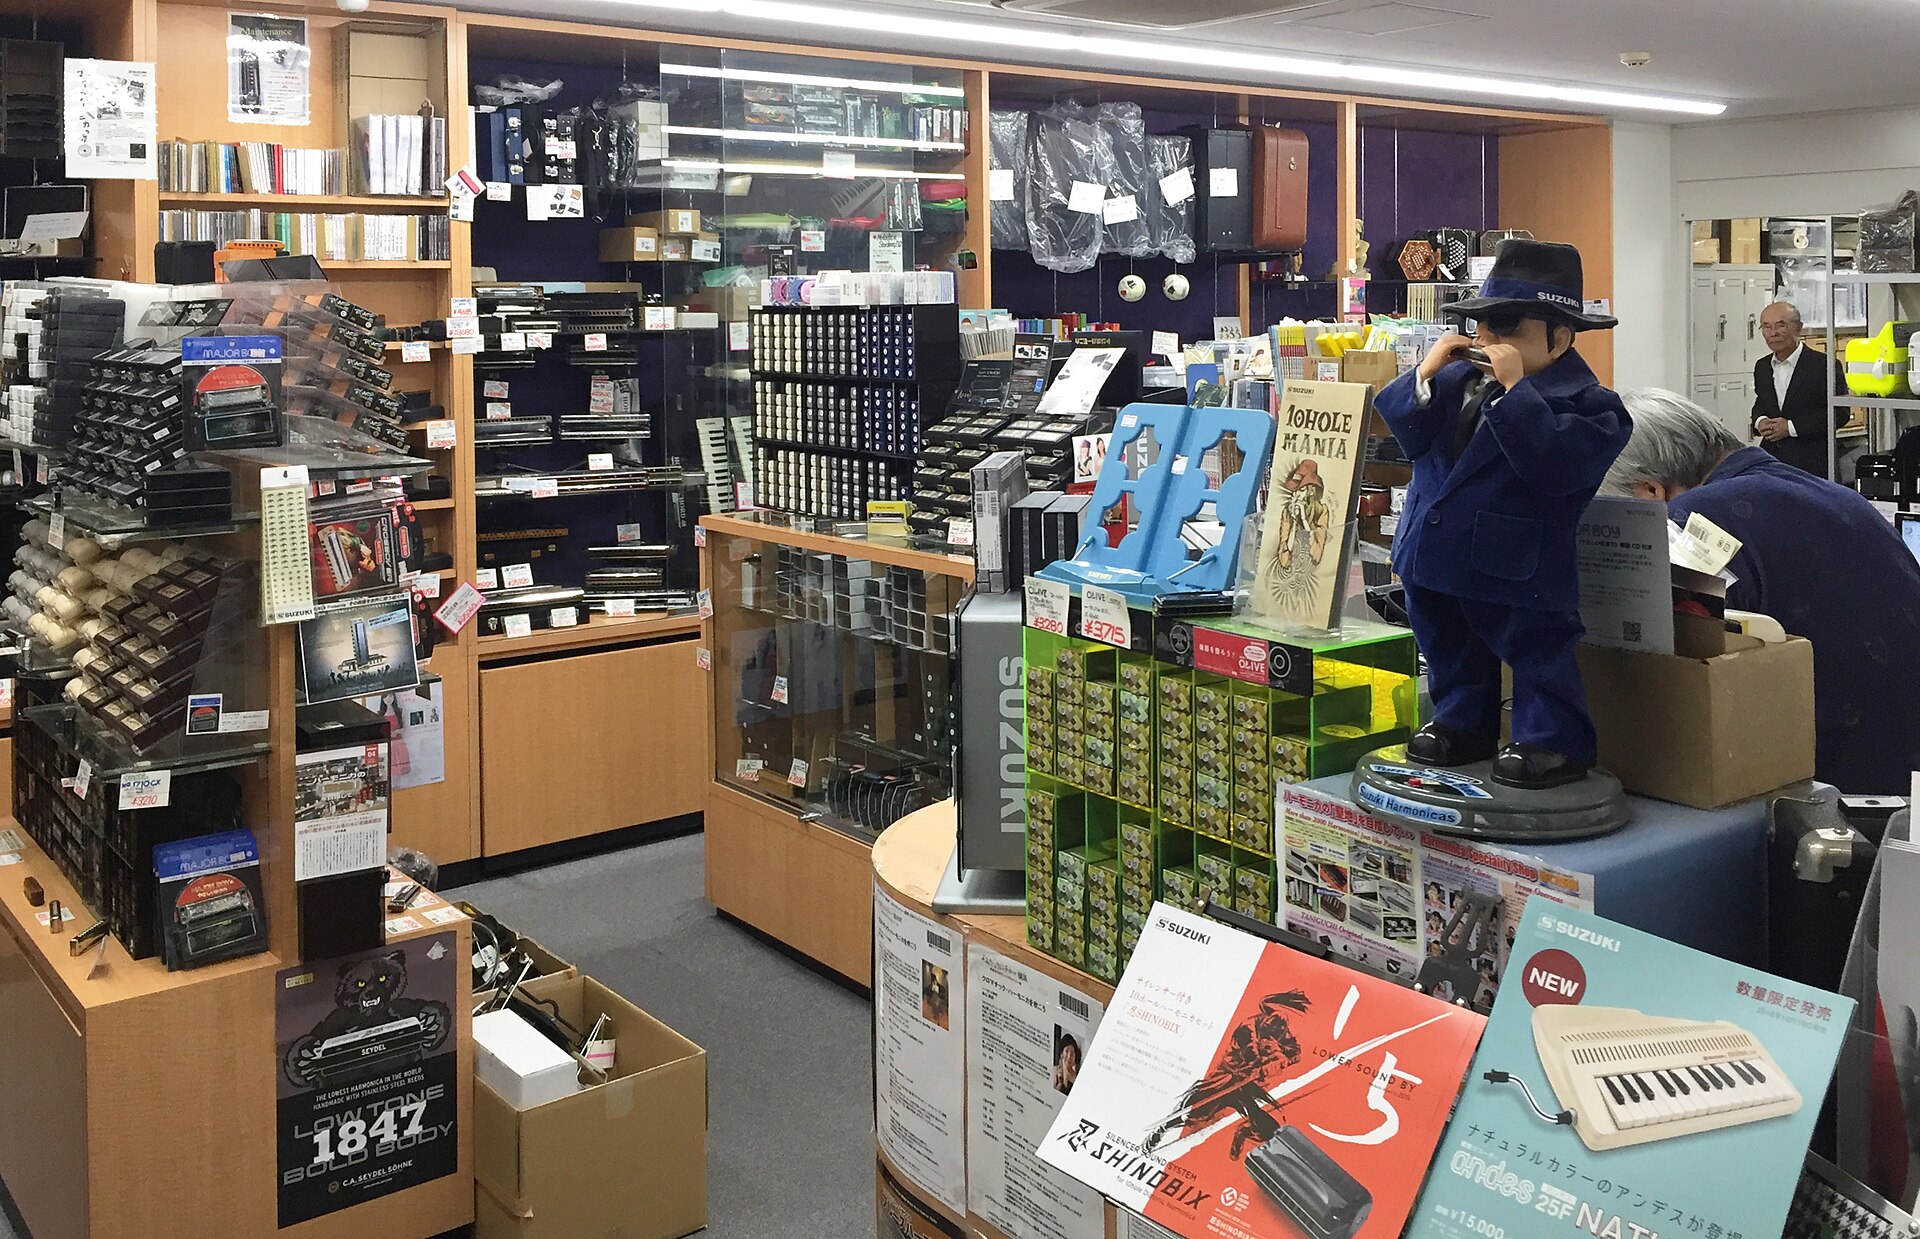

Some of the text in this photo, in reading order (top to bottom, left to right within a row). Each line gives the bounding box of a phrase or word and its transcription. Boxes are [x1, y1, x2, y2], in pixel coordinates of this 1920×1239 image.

[240, 27, 292, 36] Maintenance
[1537, 291, 1579, 308] SUZUKI
[203, 349, 240, 358] MAJOR
[1286, 404, 1352, 434] 10HOLE
[1281, 433, 1347, 460] MANIA
[381, 517, 393, 582] CROSSOVER
[1028, 586, 1047, 598] OLIVE
[1086, 590, 1105, 602] OLIVE
[284, 610, 312, 618] SUZUKI
[1033, 616, 1063, 634] ¥3280
[999, 656, 1026, 833] SUZUKI
[1360, 785, 1457, 823] Suzuki Harmonicas
[180, 857, 217, 872] MAJOR
[1420, 831, 1467, 857] Harmonica
[1467, 846, 1513, 875] Speciality
[1513, 859, 1538, 882] Shop
[1168, 922, 1211, 945] SUZUKI
[1300, 911, 1338, 930] TANIGUCHI
[1556, 921, 1621, 953] SUZUKI
[1529, 967, 1579, 998] NEW
[1736, 979, 1832, 1021] 数量限定発売
[361, 1043, 387, 1056] SEYDEL
[316, 1091, 327, 1102] THE
[327, 1086, 350, 1099] LOWEST
[350, 1076, 383, 1092] HARMONICA
[391, 1072, 403, 1081] THE
[403, 1067, 422, 1078] WORLD
[1312, 1046, 1417, 1092] LOWER SOUND BY
[313, 1073, 425, 1110] HANDMADE WITH STAINLESS STEEL REEDS
[294, 1083, 445, 1140] LOW TONE
[313, 1099, 427, 1164] 1847
[283, 1121, 454, 1186] BOLD BODY
[1105, 1131, 1198, 1182] SILENCER SOUND SYSTEM
[342, 1178, 357, 1187] C.A.
[357, 1169, 388, 1183] SEYDEL
[387, 1159, 414, 1174] SÖHNE
[1090, 1141, 1212, 1210] SHINOBIX
[1450, 1150, 1535, 1204] andes
[1535, 1194, 1577, 1220] 25F
[1576, 1202, 1659, 1239] NAT
[1450, 1210, 1505, 1239] ¥15,000
